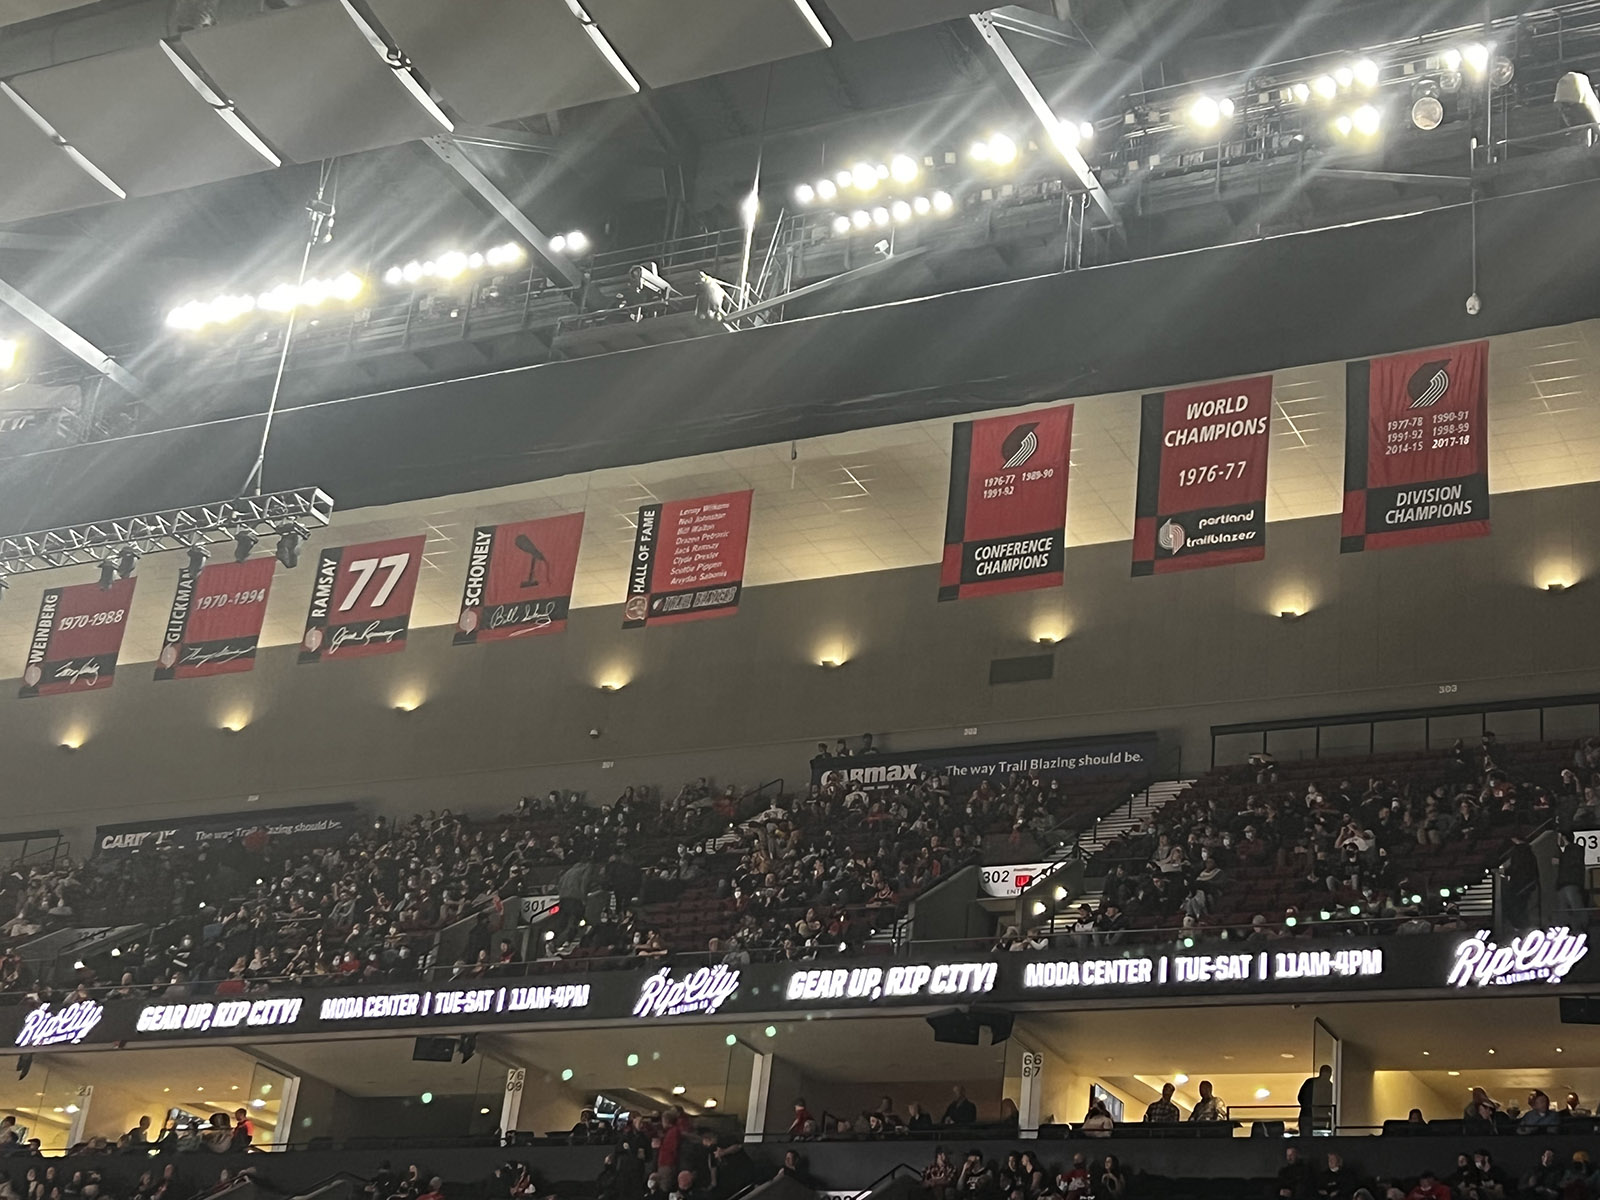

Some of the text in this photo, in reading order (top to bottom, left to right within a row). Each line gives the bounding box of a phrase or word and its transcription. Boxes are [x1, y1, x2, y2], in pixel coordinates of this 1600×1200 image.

[1186, 395, 1249, 421] WORLD
[1387, 410, 1470, 431] 1977-78 1990-91
[1164, 416, 1268, 448] CHAMPIONS
[1387, 422, 1470, 443] 1991-92 1998-99
[1385, 435, 1471, 455] 2014-15 2017-18
[984, 474, 1016, 488] 1976-77
[1178, 460, 1247, 487] 1976-77
[983, 486, 1015, 499] 1991-92
[1396, 484, 1463, 507] DIVISION
[1198, 509, 1255, 529] portland
[1385, 500, 1473, 525] CHAMPIONS
[633, 510, 655, 593] HALL OF FAME
[974, 537, 1053, 561] CONFERENCE
[465, 531, 492, 606] SCHONELY
[976, 553, 1049, 576] CHAMPIONS
[312, 558, 337, 617] RAMSAY
[338, 553, 410, 612] 77
[198, 588, 265, 610] 1970-1994
[29, 594, 58, 663] WEINBERG
[58, 609, 124, 631] 1970-1988
[946, 751, 1144, 776] The way Trail Blazing should be.
[1574, 835, 1598, 849] 03
[983, 871, 1010, 883] 302
[523, 900, 546, 912] 301
[1024, 961, 1080, 987] MODA
[1081, 958, 1153, 985] CENTER
[1174, 954, 1253, 982] TUE-SAT
[1275, 949, 1383, 979] 11AM-4PM
[1447, 926, 1589, 988] Rip City
[786, 963, 998, 1001] GEAR UP, RIP CITY!
[319, 996, 364, 1020] MODA
[363, 994, 420, 1017] CENTER
[433, 989, 495, 1014] TUE-SAT
[508, 984, 591, 1011] 11AM-4PM
[136, 998, 303, 1032] GEAR UP, RIP CITY!
